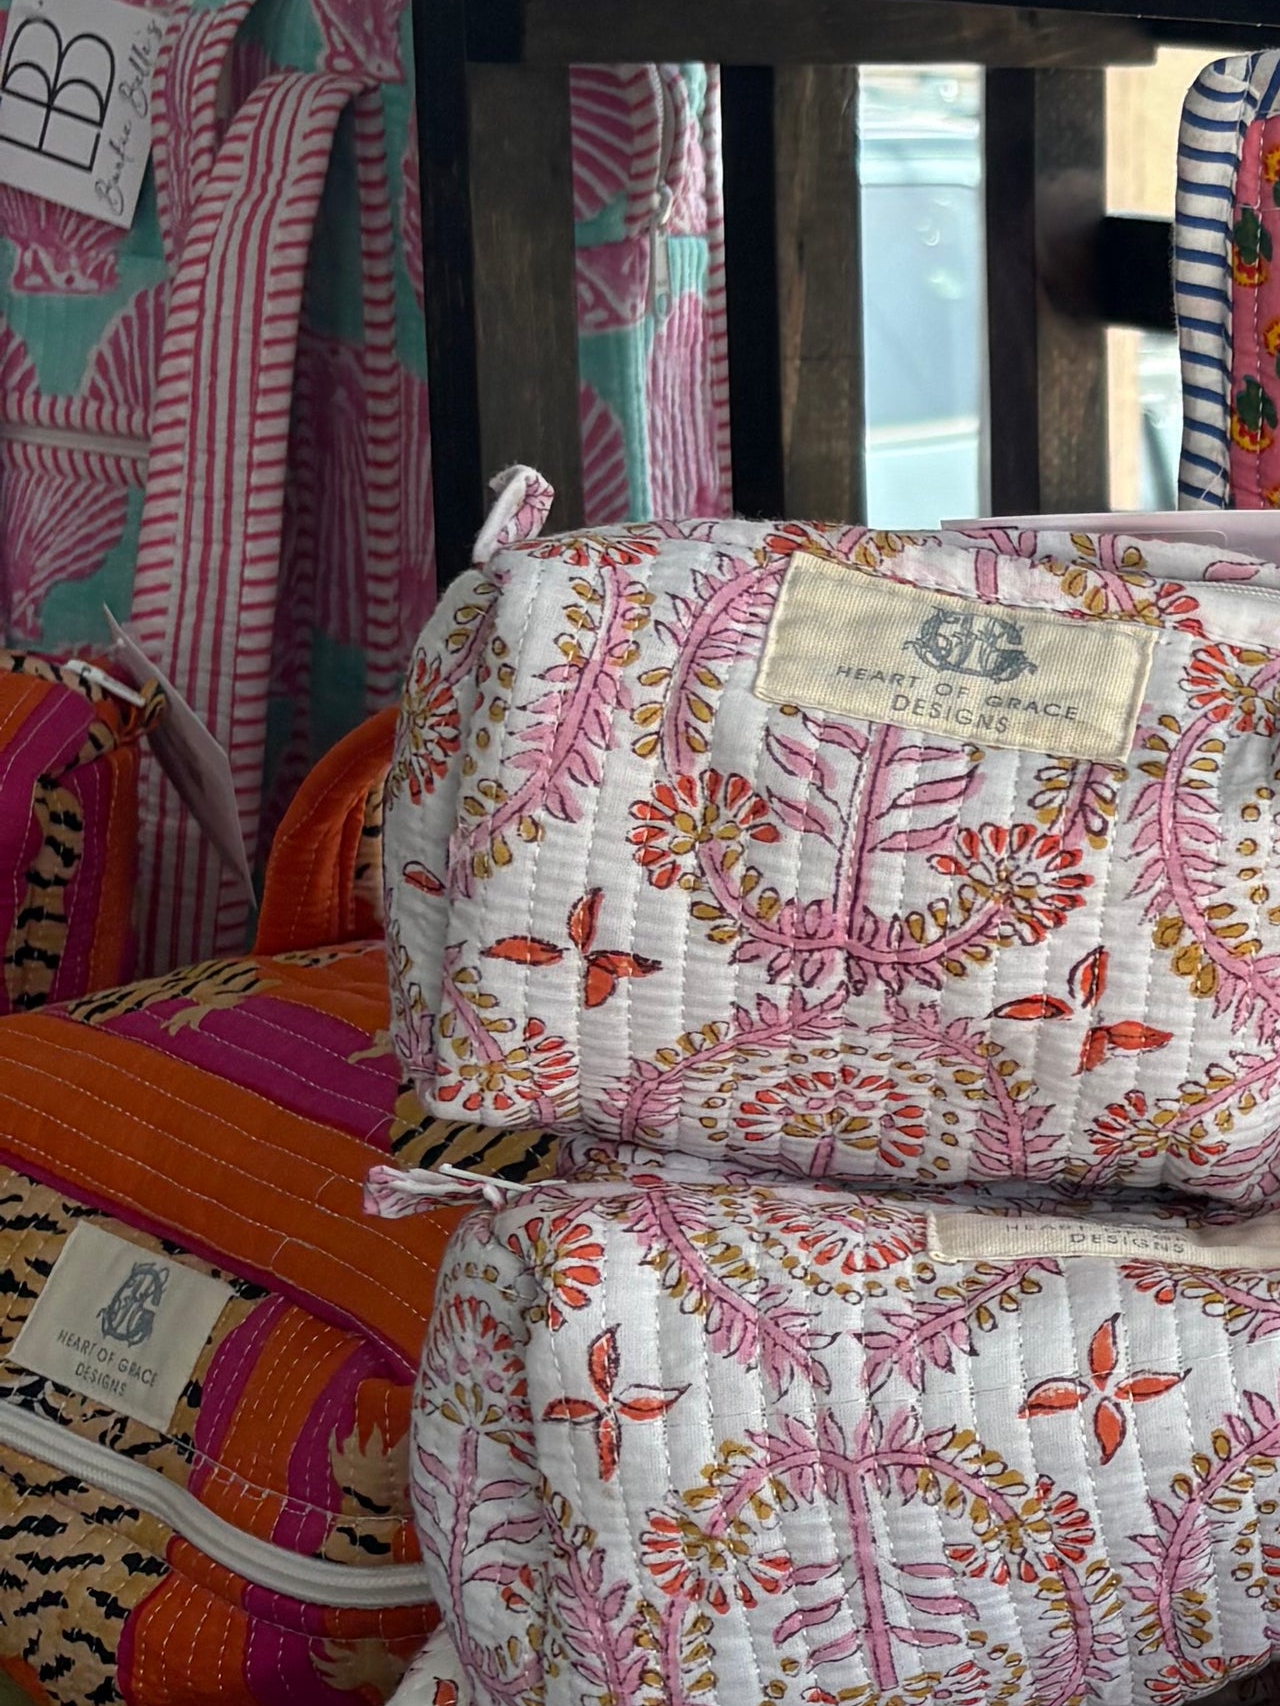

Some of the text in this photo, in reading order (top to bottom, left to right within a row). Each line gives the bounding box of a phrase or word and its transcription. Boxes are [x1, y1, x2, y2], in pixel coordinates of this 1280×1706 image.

[836, 664, 1079, 722] HEART OF GRACE
[891, 693, 1009, 735] DESIGNS
[1070, 1233, 1185, 1254] DESIGNS
[56, 1328, 159, 1388] HEART OF GRACE
[74, 1363, 128, 1397] DESIGNS
